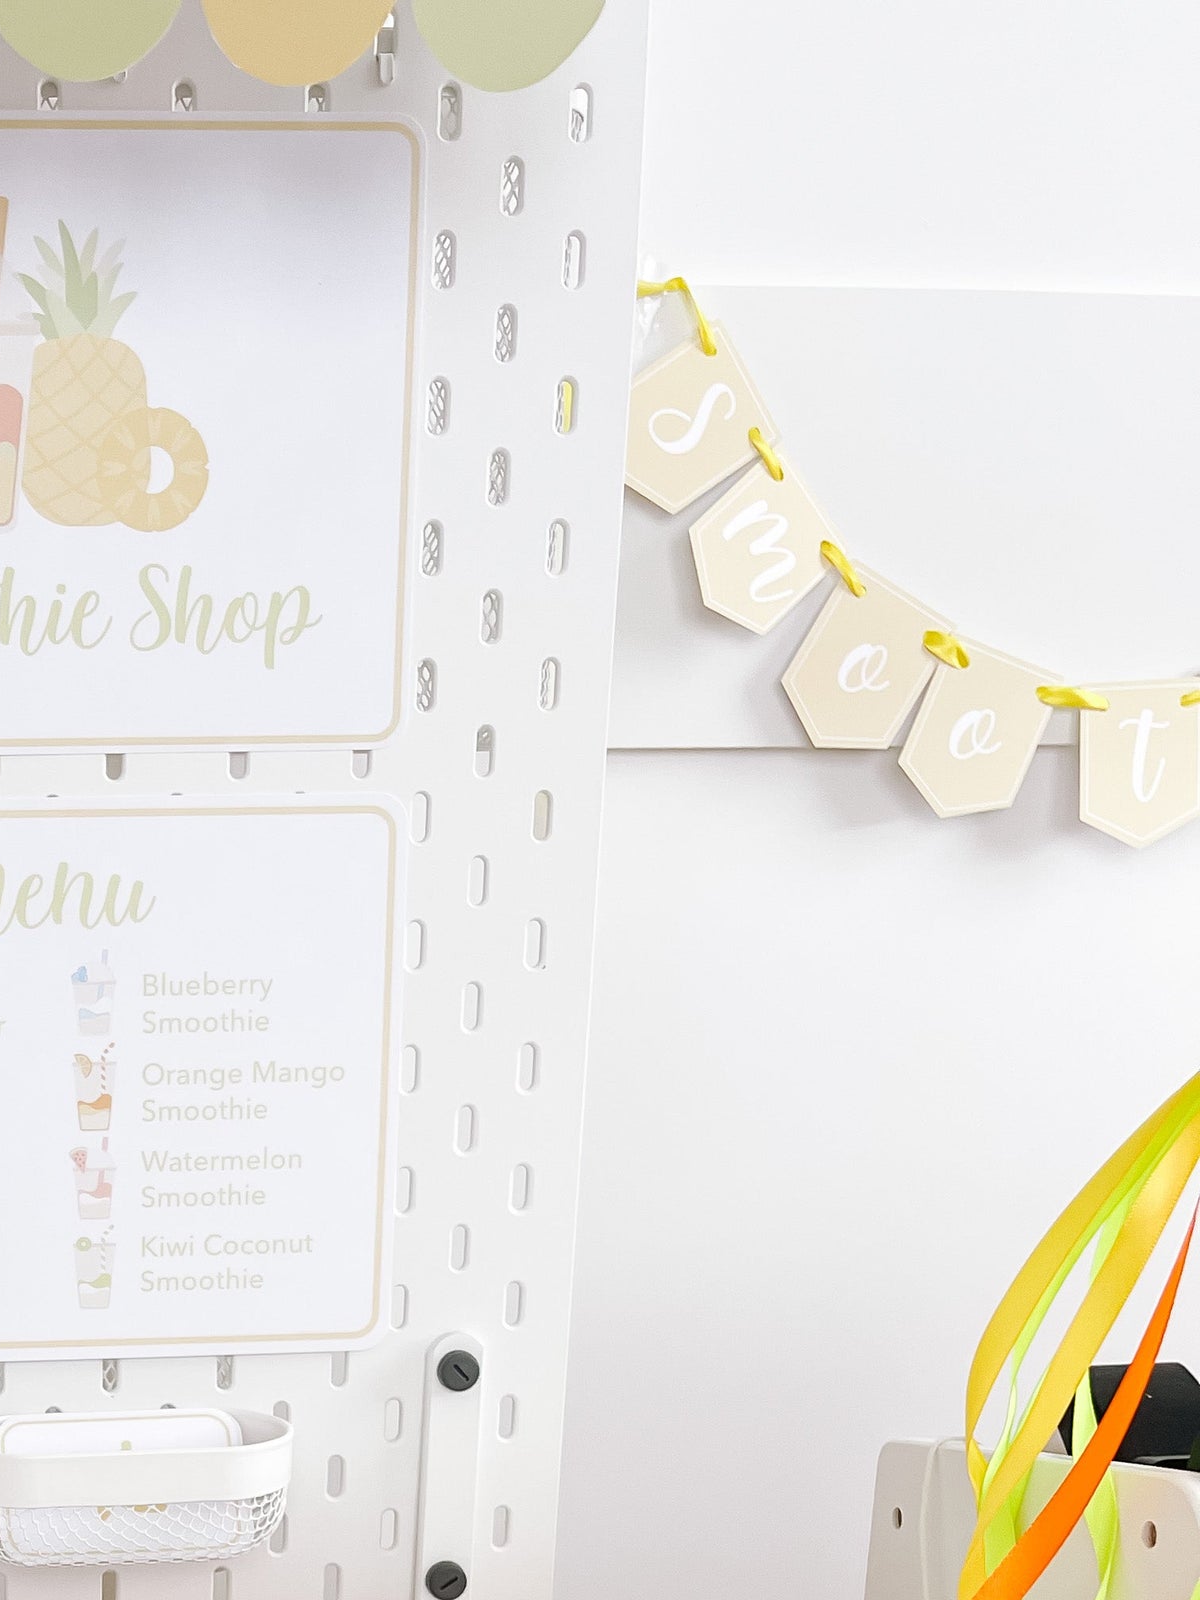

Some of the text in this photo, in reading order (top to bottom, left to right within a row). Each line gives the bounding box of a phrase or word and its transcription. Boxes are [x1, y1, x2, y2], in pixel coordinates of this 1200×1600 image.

[130, 563, 322, 670] Shop
[142, 971, 273, 1002] Blueberry
[142, 1010, 270, 1034] Smoothie
[142, 1061, 345, 1091] Orange Mango
[142, 1098, 268, 1122] Smoothie
[141, 1147, 302, 1174] Watermelon
[141, 1184, 266, 1208] Smoothie
[141, 1234, 312, 1258] Kiwi Coconut
[140, 1269, 264, 1292] Smoothie
